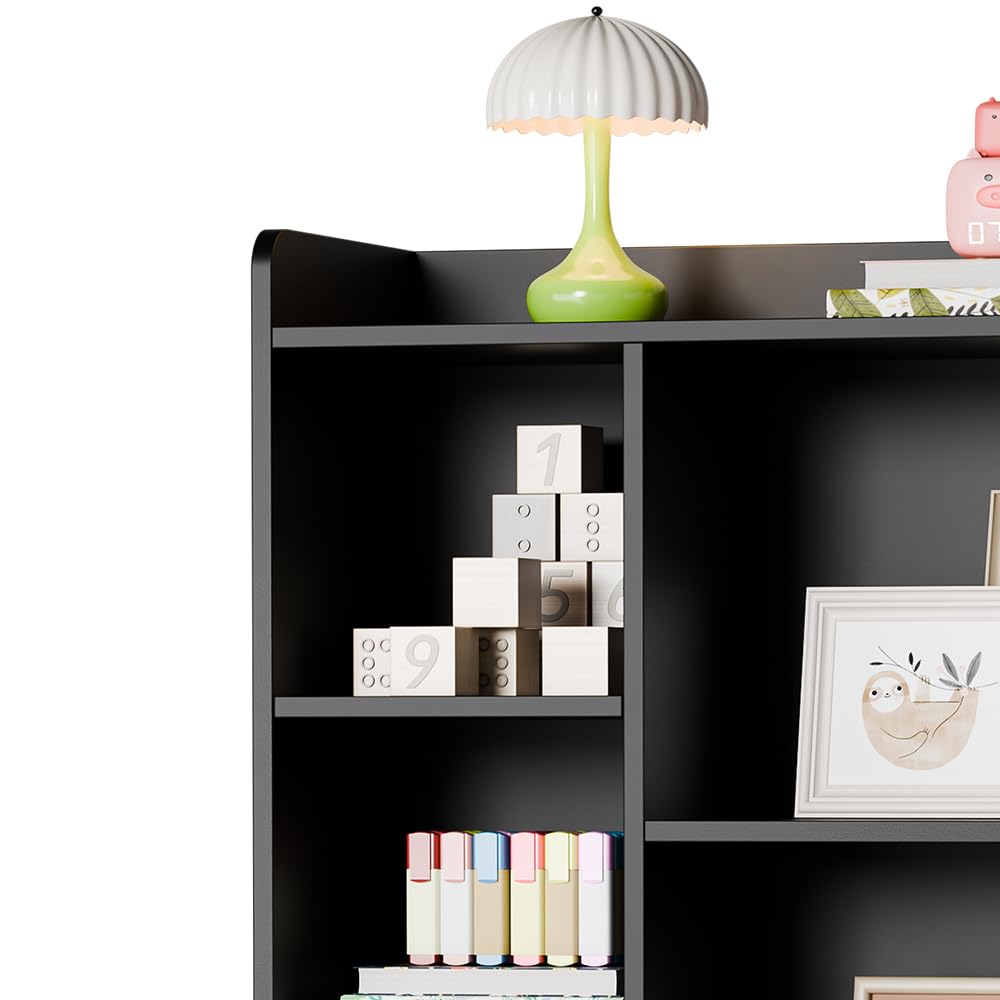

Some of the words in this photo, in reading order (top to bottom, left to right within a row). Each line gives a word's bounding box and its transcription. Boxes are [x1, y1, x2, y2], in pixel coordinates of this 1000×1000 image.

[536, 432, 562, 487] 1
[541, 568, 574, 622] 5
[405, 634, 440, 689] 9
